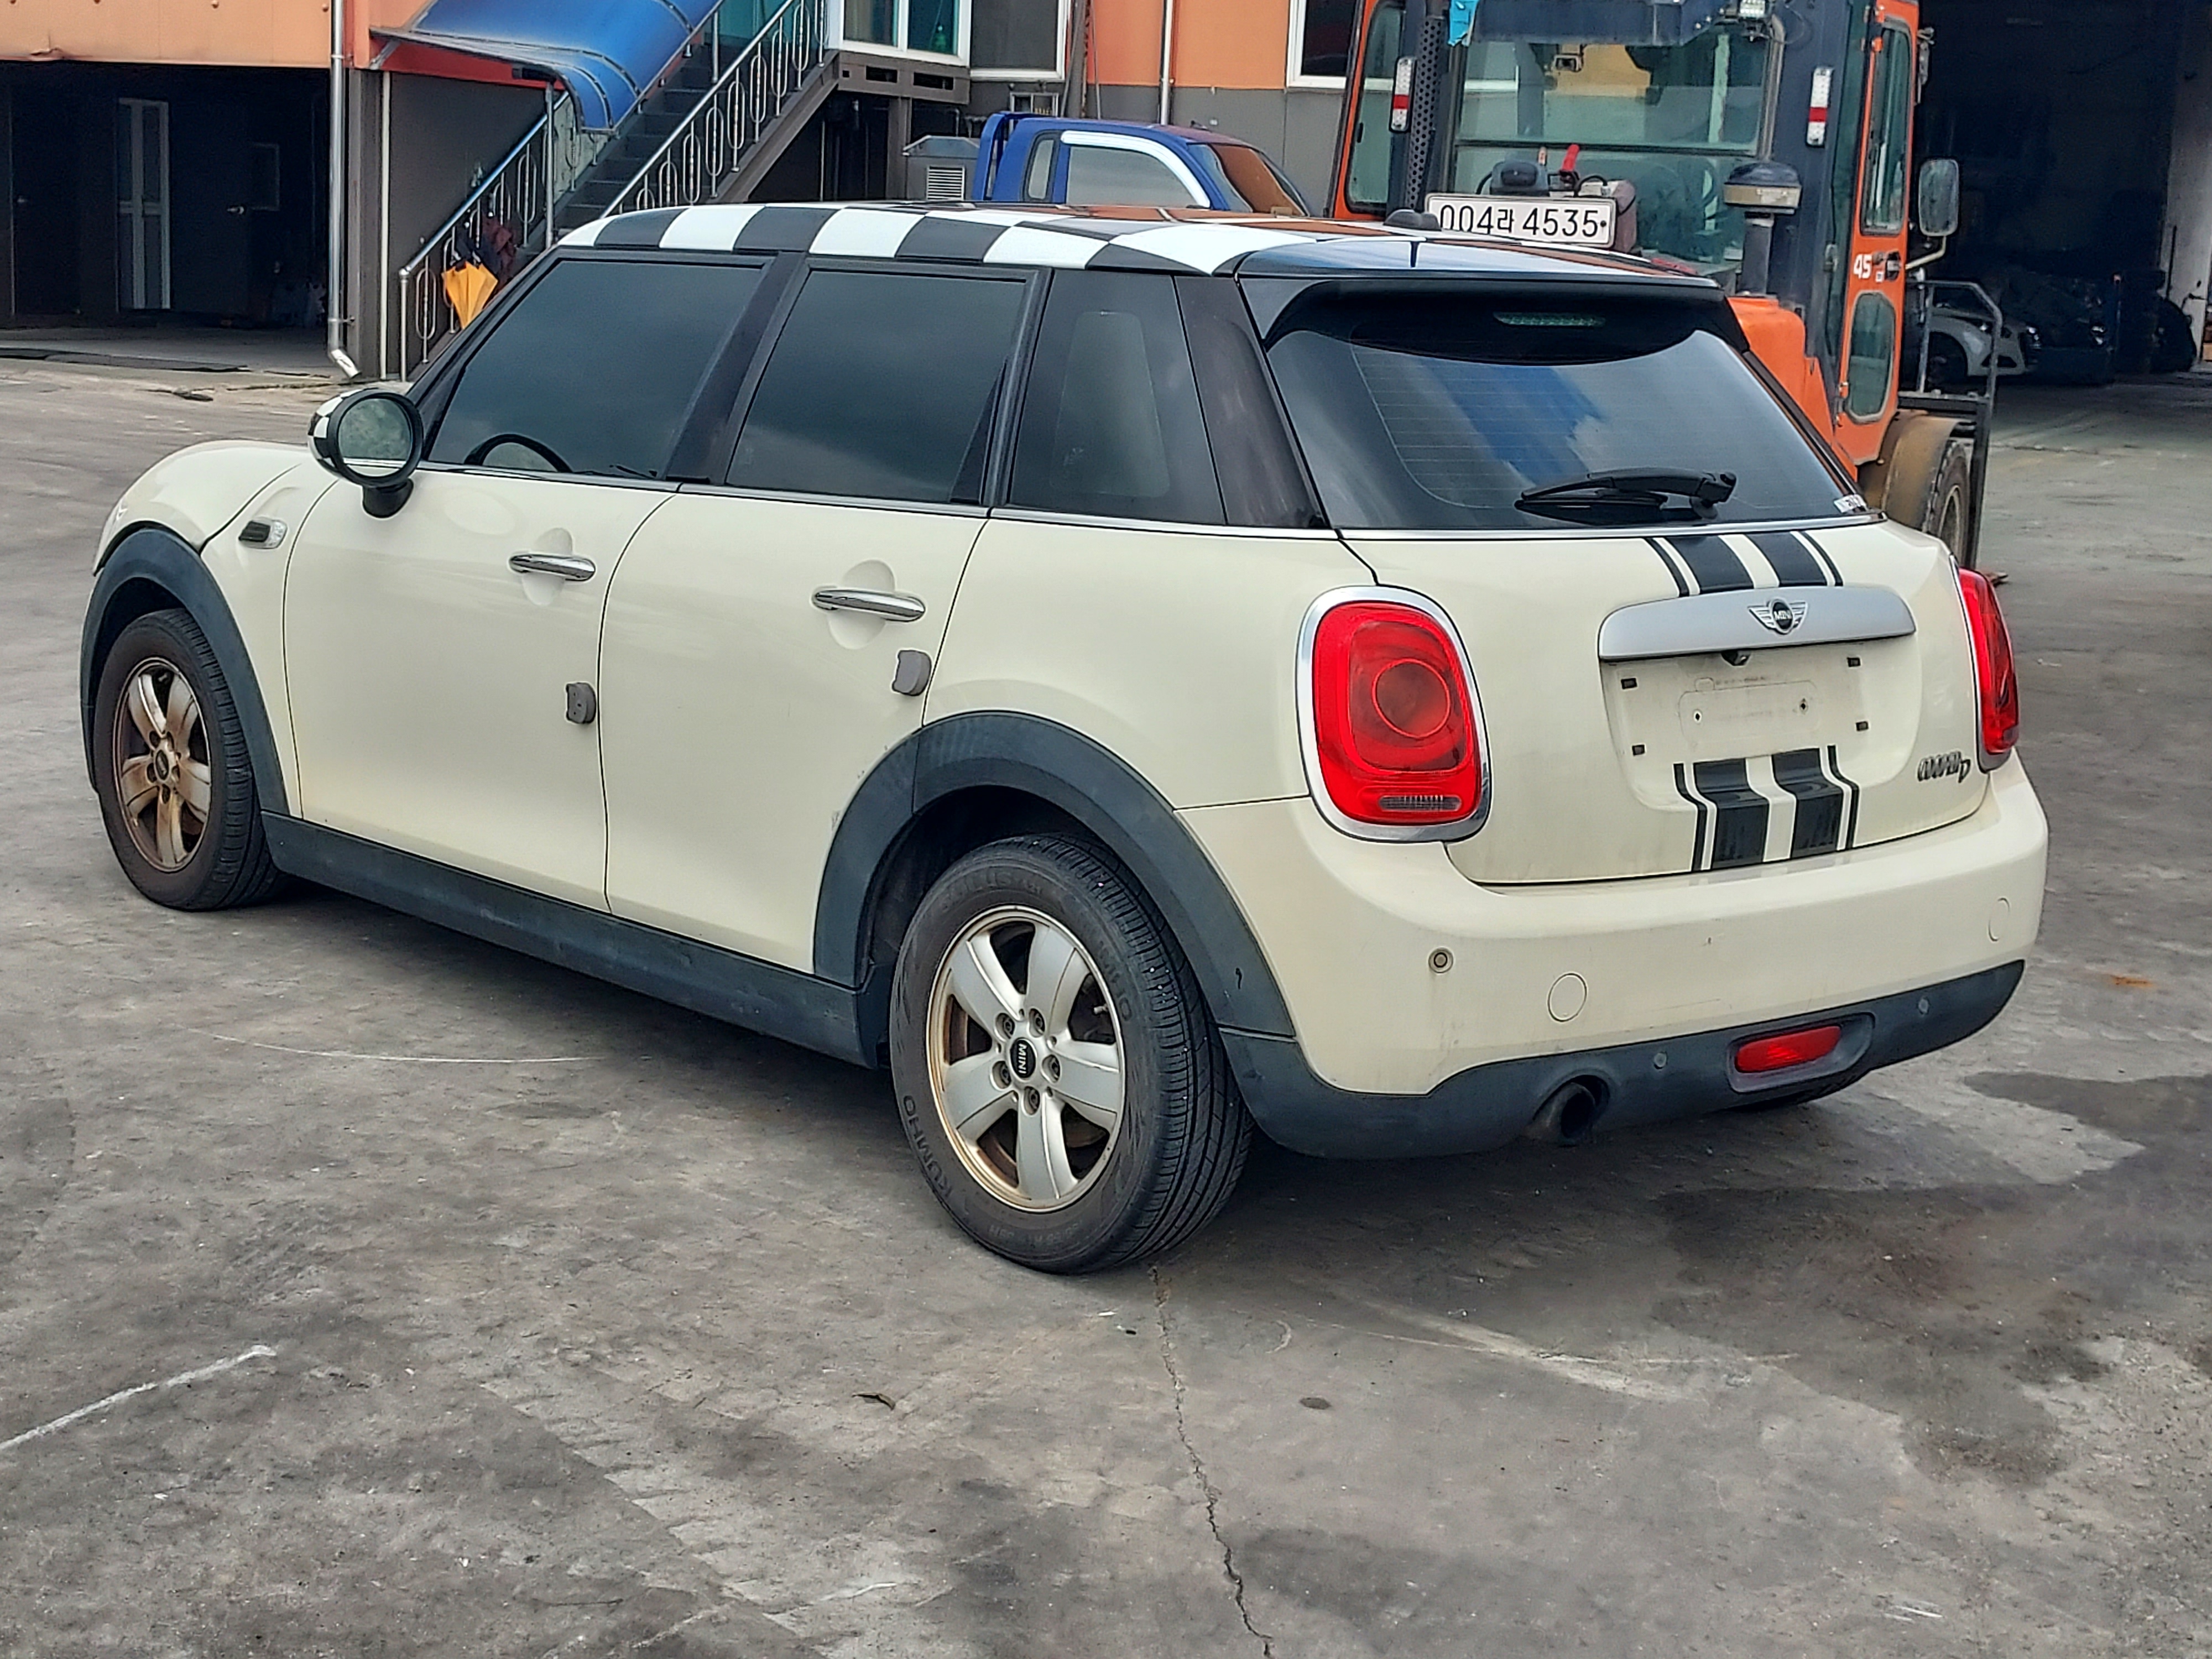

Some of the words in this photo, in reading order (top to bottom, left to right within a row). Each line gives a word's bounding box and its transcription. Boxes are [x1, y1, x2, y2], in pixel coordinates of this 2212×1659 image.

[1440, 204, 1515, 234] 004라
[1522, 207, 1598, 237] 4535
[1854, 254, 1872, 279] 45
[1018, 1043, 1027, 1074] MINI
[903, 1095, 953, 1198] KUMHO
